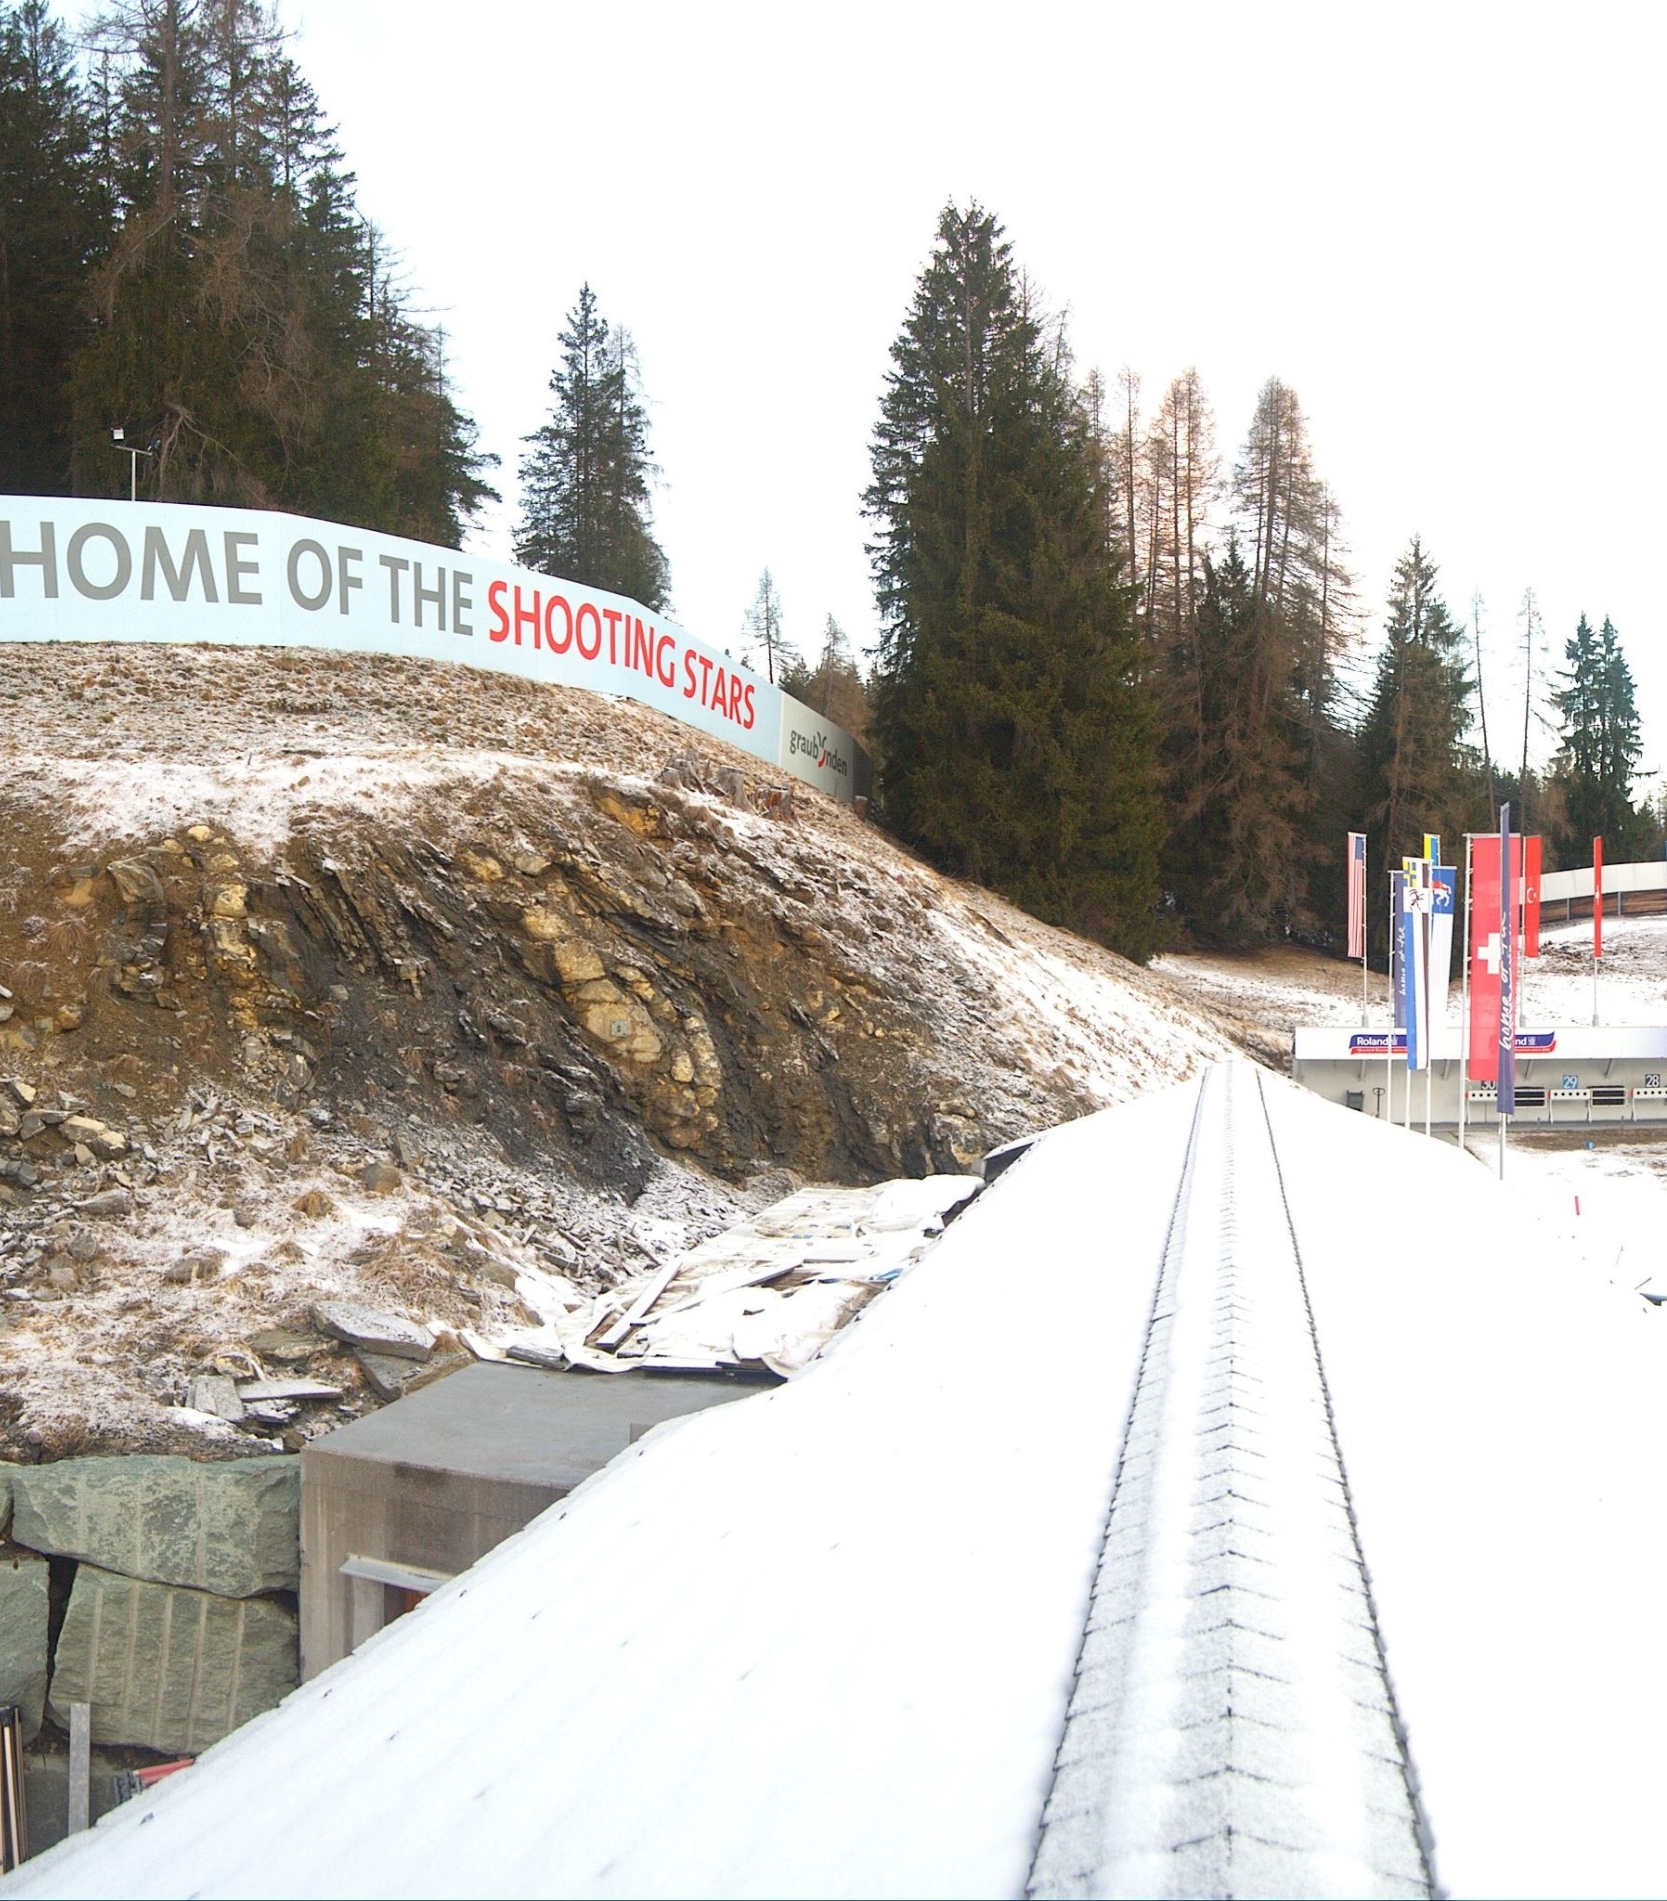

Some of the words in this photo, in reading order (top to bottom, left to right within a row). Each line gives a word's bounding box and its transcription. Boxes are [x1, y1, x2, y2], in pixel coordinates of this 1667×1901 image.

[286, 538, 363, 616] OF
[378, 553, 473, 636] THE
[487, 580, 676, 688] SHOOTING
[683, 650, 755, 730] STARS
[1563, 1076, 1577, 1089] 29
[1646, 1075, 1659, 1088] 28
